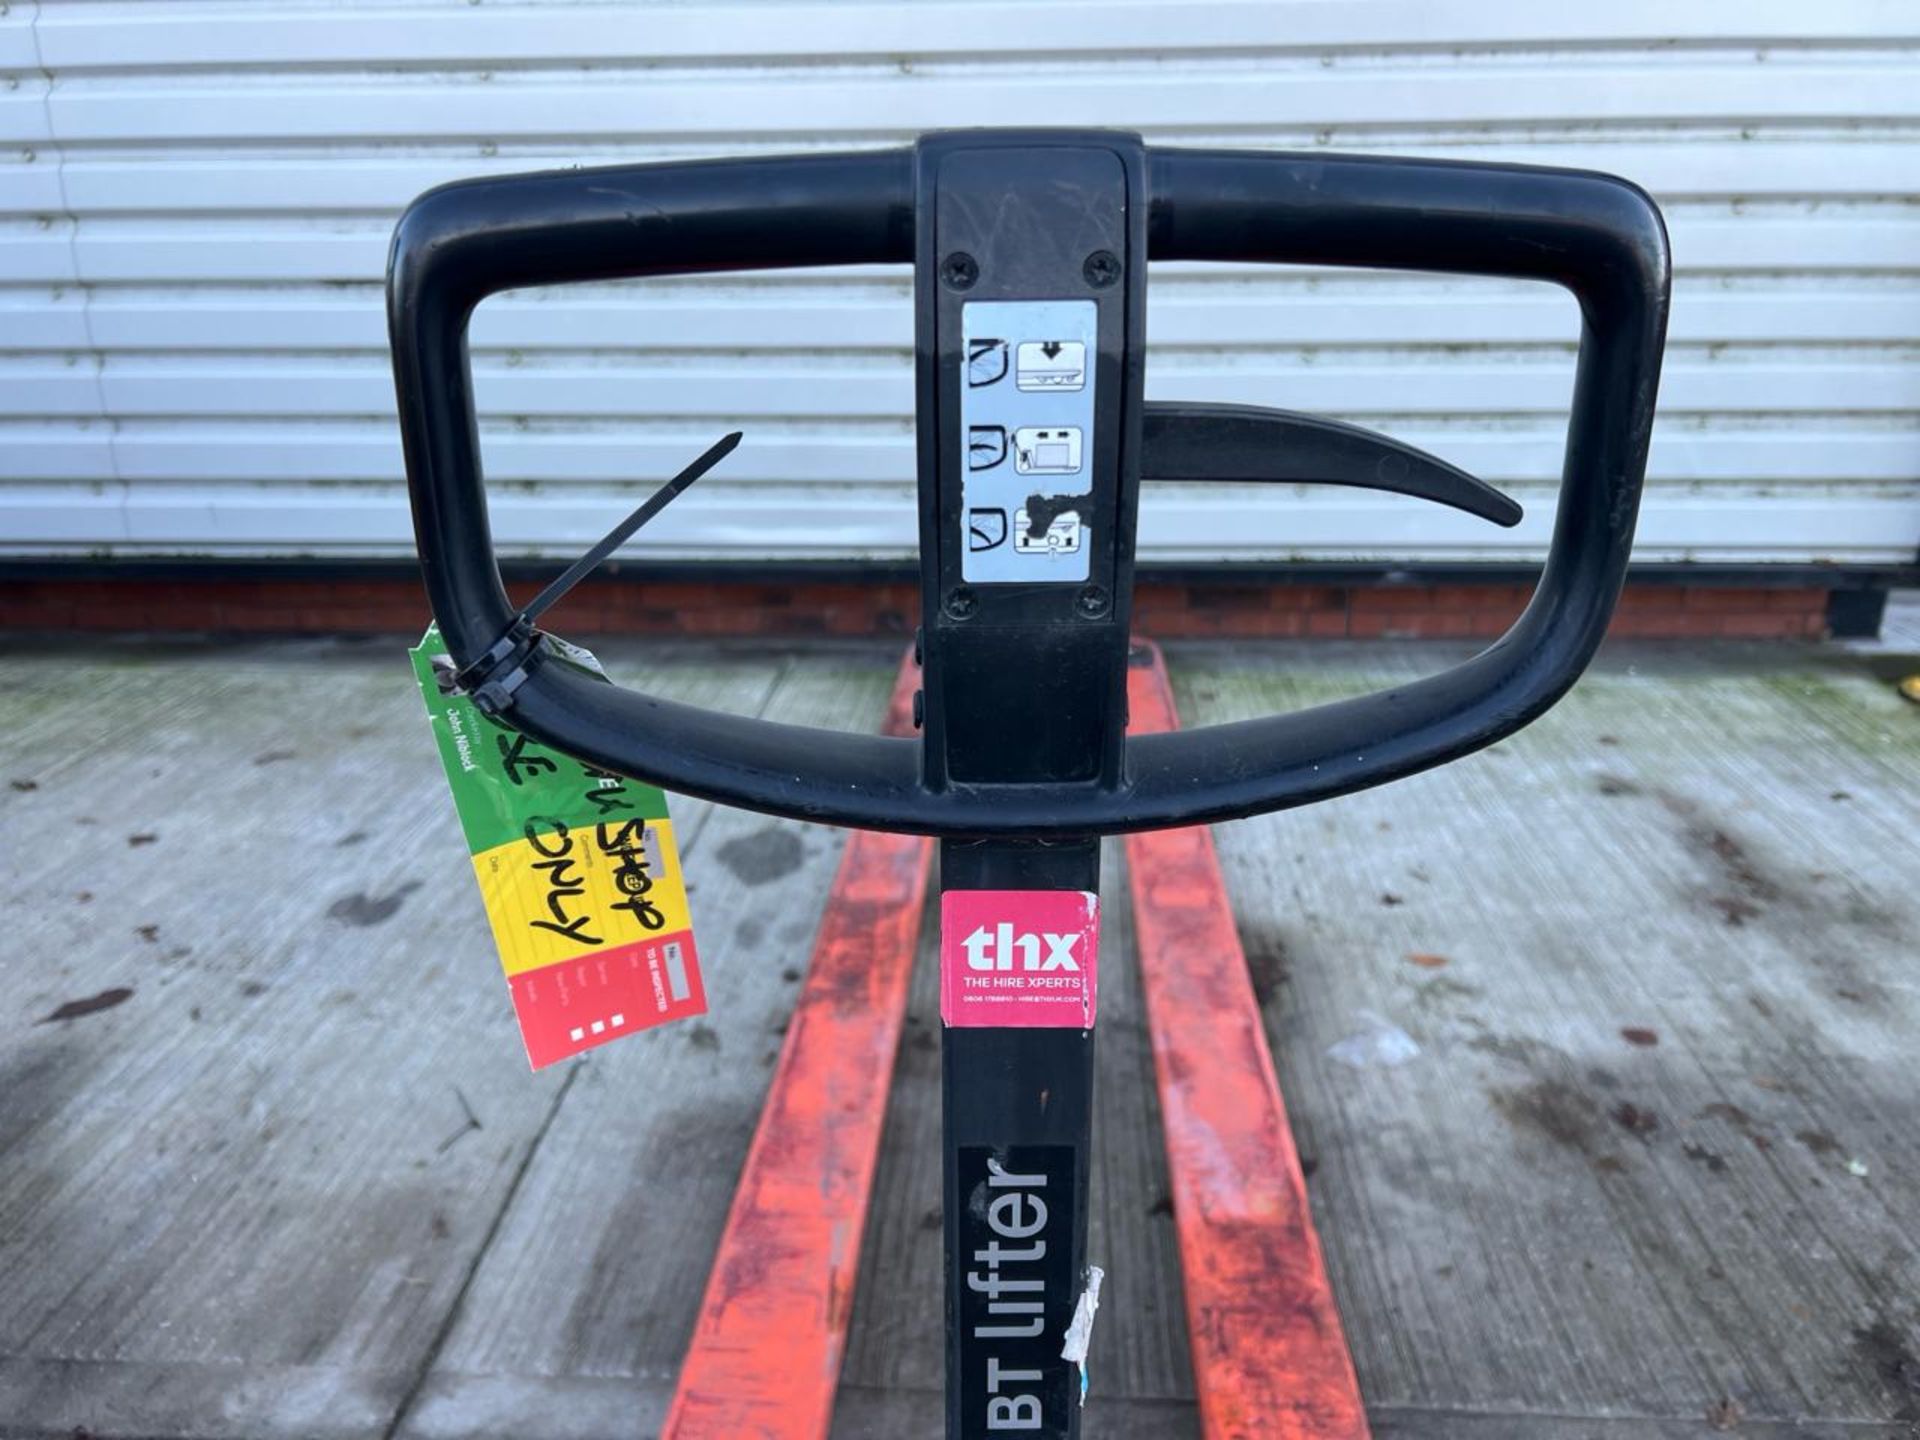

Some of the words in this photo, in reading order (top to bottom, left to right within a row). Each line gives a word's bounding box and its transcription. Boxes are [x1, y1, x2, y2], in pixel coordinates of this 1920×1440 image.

[446, 707, 464, 733] John
[454, 733, 476, 772] Niblock
[524, 815, 603, 945] ONLY
[597, 817, 665, 930] SHOP
[961, 922, 1081, 971] thx
[651, 969, 667, 1012] INSPECTED
[964, 977, 990, 988] THE
[994, 977, 1024, 988] HIRE
[1028, 977, 1081, 988] XPERTS
[967, 1158, 1048, 1337] lifter
[987, 1358, 1043, 1429] BT
